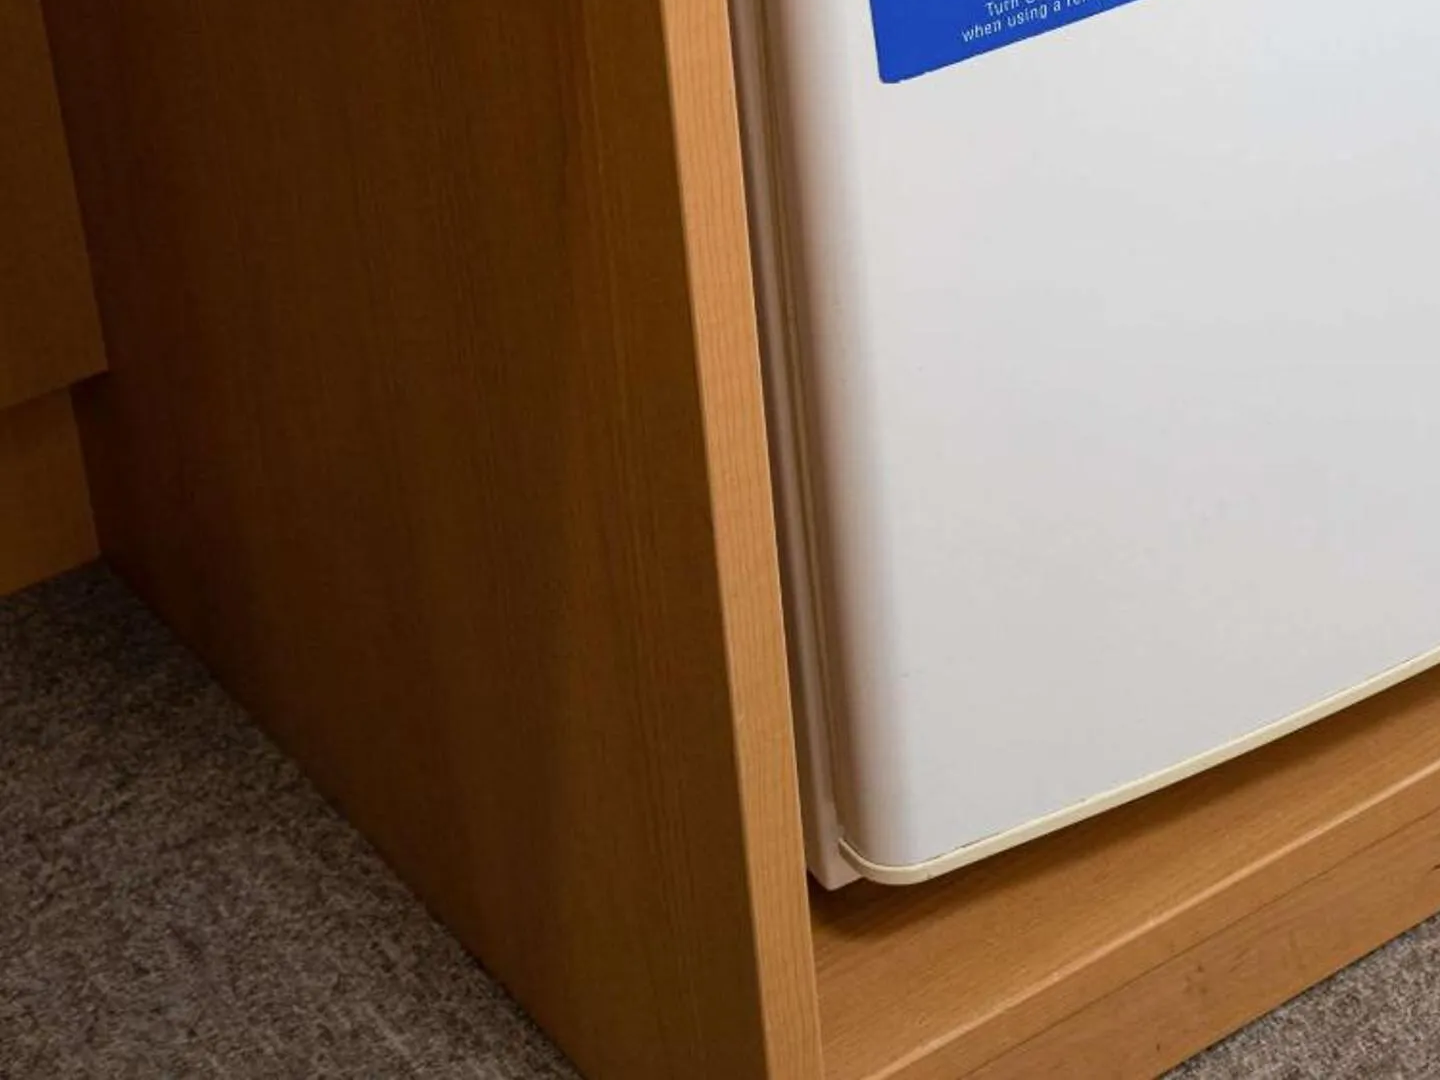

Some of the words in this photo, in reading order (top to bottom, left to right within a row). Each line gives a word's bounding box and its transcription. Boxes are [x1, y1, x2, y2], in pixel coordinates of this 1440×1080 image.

[961, 19, 1002, 42] when
[1007, 4, 1048, 27] using
[1053, 0, 1061, 12] a
